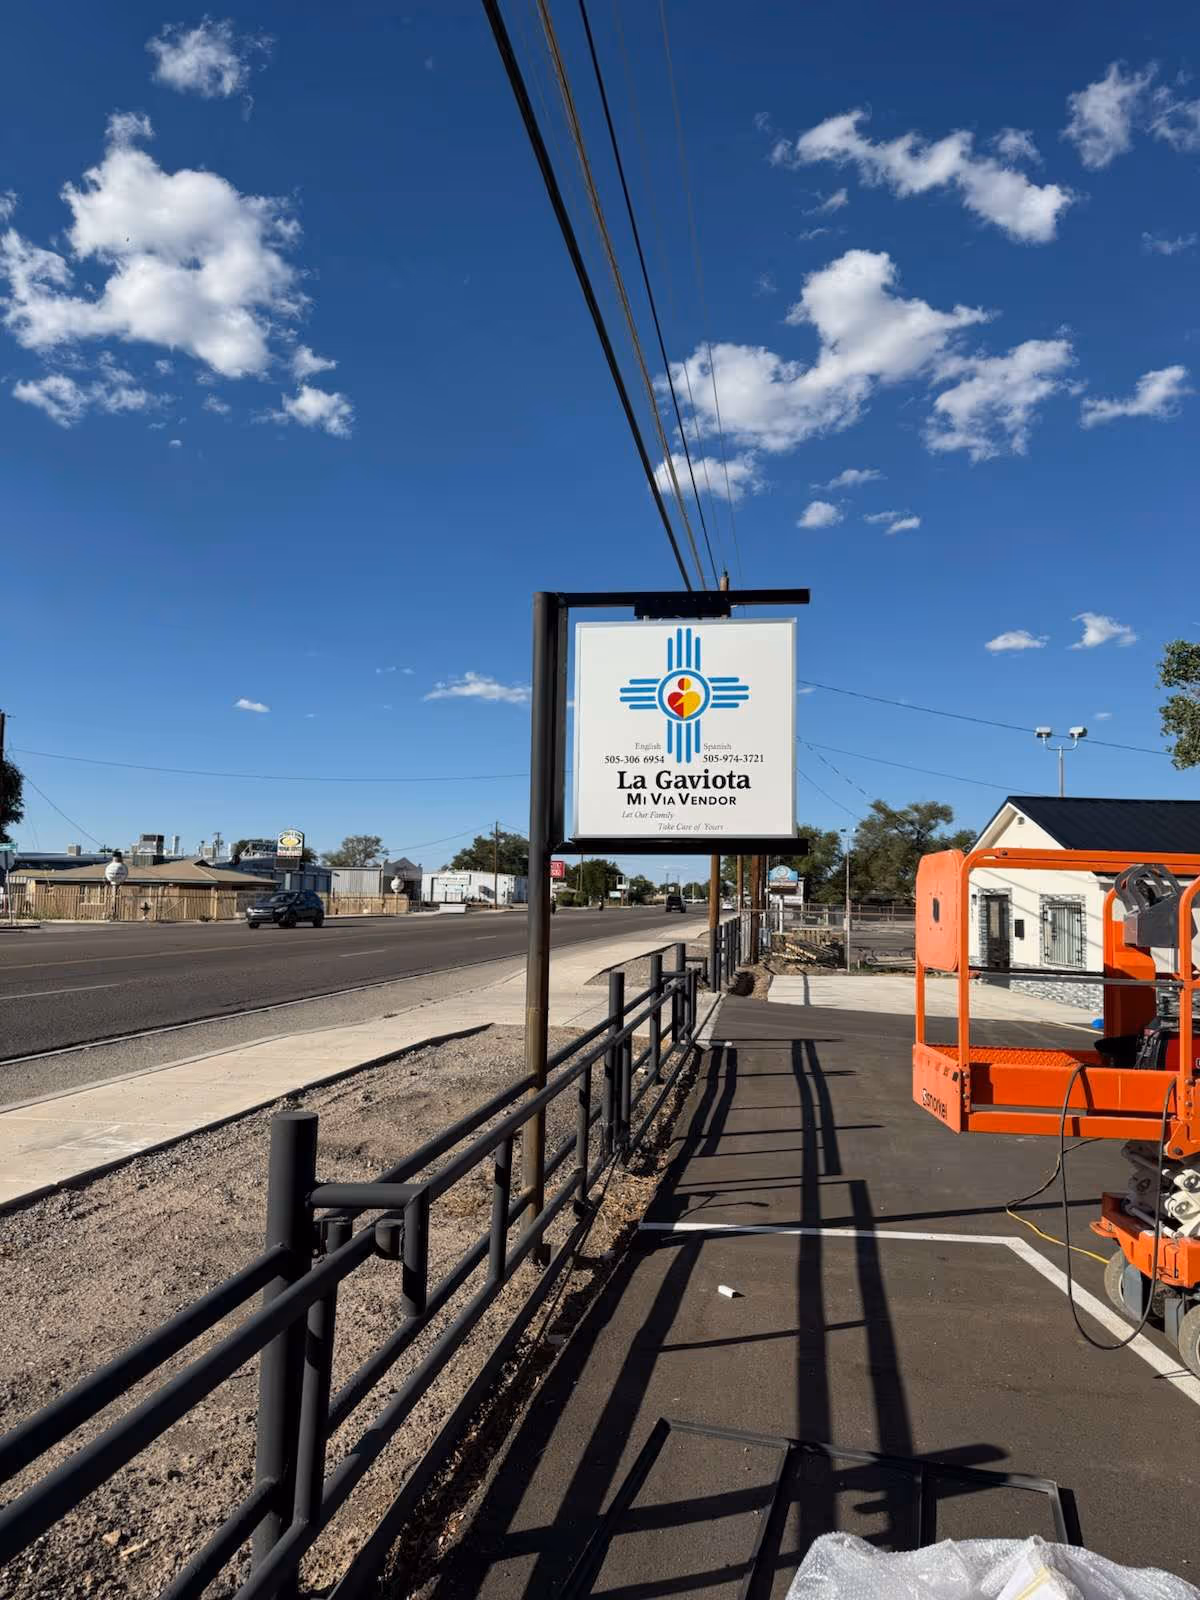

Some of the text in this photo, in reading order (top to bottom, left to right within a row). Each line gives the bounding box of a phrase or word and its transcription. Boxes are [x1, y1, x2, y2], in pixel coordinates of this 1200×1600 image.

[635, 742, 661, 751] English
[703, 742, 732, 751] Spanish
[604, 755, 665, 764] 505-306 6954
[702, 753, 764, 764] 505-974-3721
[617, 768, 752, 790] La Gaviota
[650, 810, 674, 820] Family
[658, 822, 724, 832] Take Care of Yours
